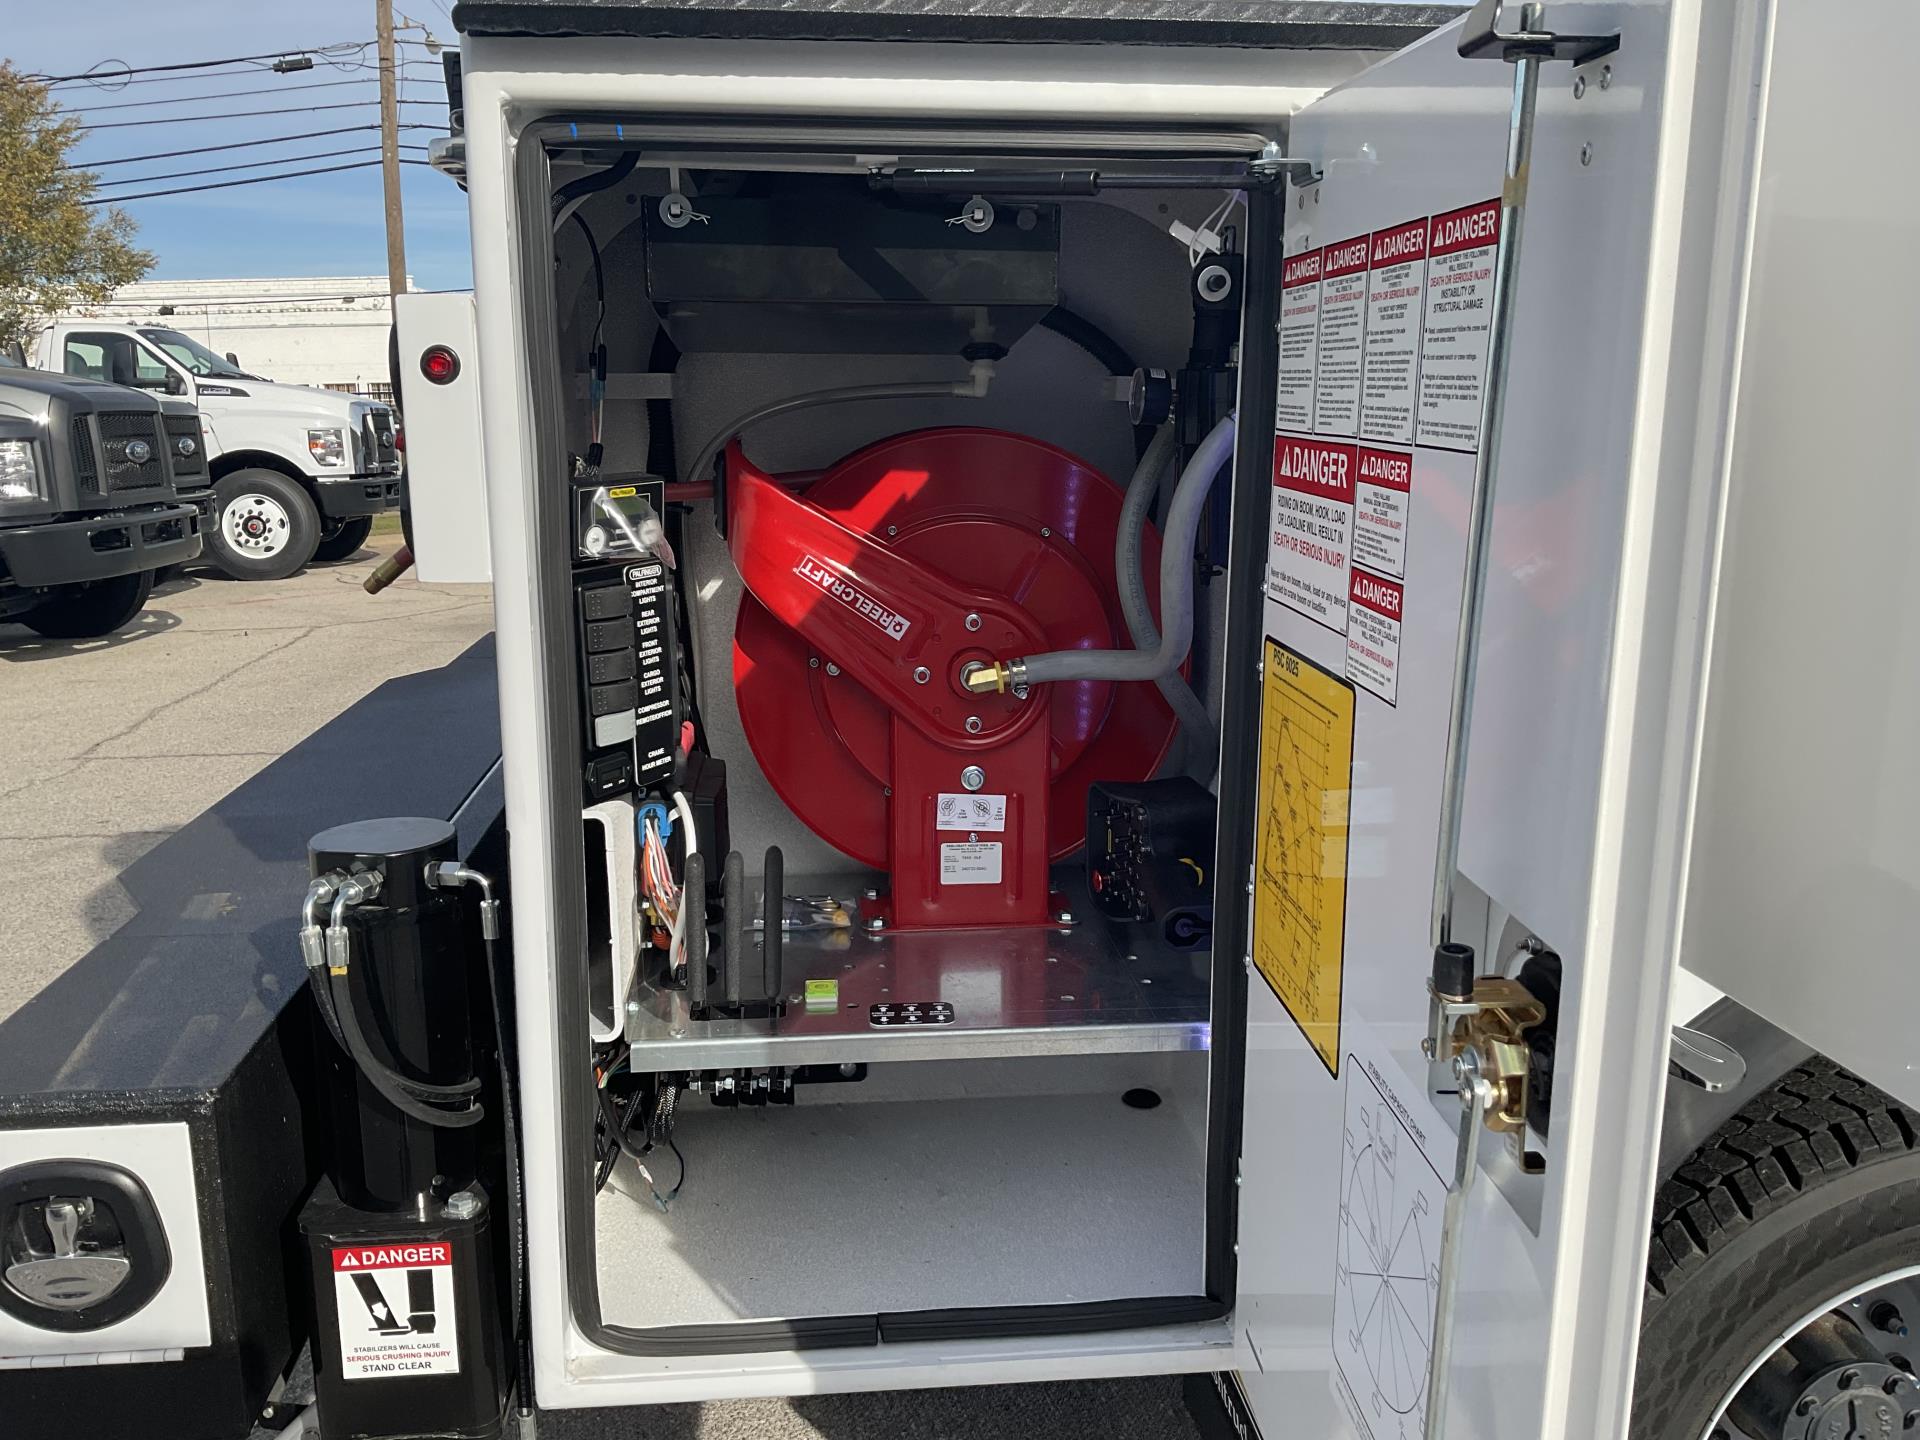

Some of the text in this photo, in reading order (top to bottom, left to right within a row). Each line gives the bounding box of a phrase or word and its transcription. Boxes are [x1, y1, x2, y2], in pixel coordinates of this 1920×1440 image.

[1446, 210, 1496, 244] DANGER
[1382, 228, 1424, 258] DANGER
[1334, 244, 1366, 268] DANGER
[1291, 256, 1320, 280] DANGER
[1429, 267, 1491, 288] DEATH OR SERIOUS INJURY
[1440, 284, 1475, 299] INSTABILITY OR
[1433, 297, 1483, 313] STRUCTURAL DAMAGE
[1293, 446, 1348, 488] DANGER
[1370, 456, 1408, 483] DANGER
[1277, 494, 1345, 525] RIDING ON BOOM, HOOK, LOAD
[1277, 512, 1343, 544] OR LOADLINE WILL RESULT IN
[1273, 530, 1289, 550] DEATH
[1290, 536, 1298, 553] OR
[1298, 539, 1322, 562] SERIOUS
[1323, 547, 1344, 570] INJURY
[632, 566, 659, 578] PALFINGER
[636, 578, 658, 588] INTERIOR
[639, 596, 656, 604] LIGHTS
[801, 562, 894, 628] REELCRAFT
[1362, 580, 1399, 612] DANGER
[642, 609, 655, 618] REAR
[637, 617, 660, 628] EXTERIOR
[640, 626, 658, 635] LIGHTS
[642, 639, 658, 648] FRONT
[638, 647, 662, 658] EXTERIOR
[642, 656, 660, 666] LIGHTS
[1273, 648, 1299, 677] PSC 6025
[644, 669, 660, 678] CARGO
[640, 677, 664, 688] EXTERIOR
[644, 686, 662, 696] LIGHTS
[638, 700, 670, 714] COMPRESSOR
[648, 748, 664, 758] CRANE
[642, 756, 672, 772] HOUR METER
[1410, 1118, 1426, 1143] CHART
[362, 1247, 446, 1265] DANGER
[354, 1344, 398, 1353] STABILIZERS
[346, 1354, 380, 1362] SERIOUS
[382, 1352, 422, 1360] CRUSHING
[362, 1361, 432, 1373] STAND CLEAR
